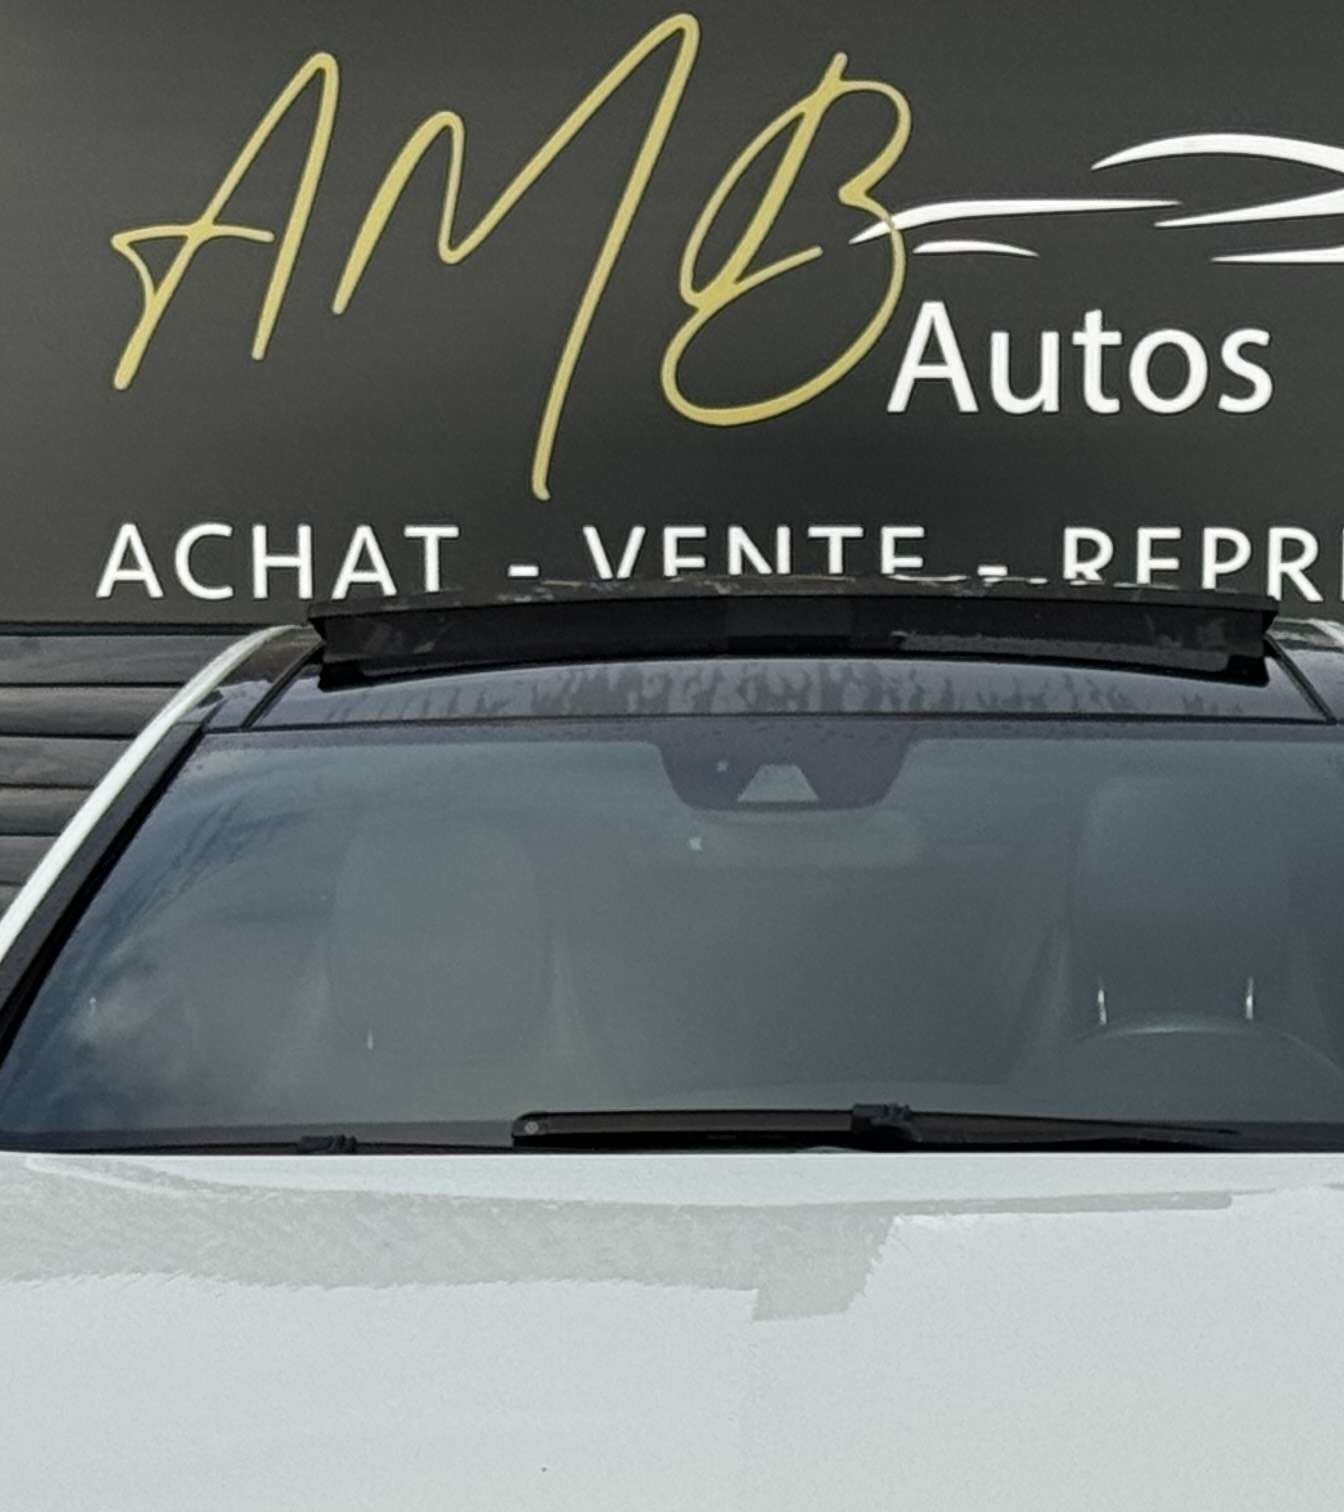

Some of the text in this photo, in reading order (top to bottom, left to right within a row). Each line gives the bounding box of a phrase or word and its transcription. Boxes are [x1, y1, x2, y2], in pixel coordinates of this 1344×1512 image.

[111, 13, 1274, 500] AMB Autos
[95, 521, 460, 600] ACHAT
[581, 524, 926, 579] VENTE
